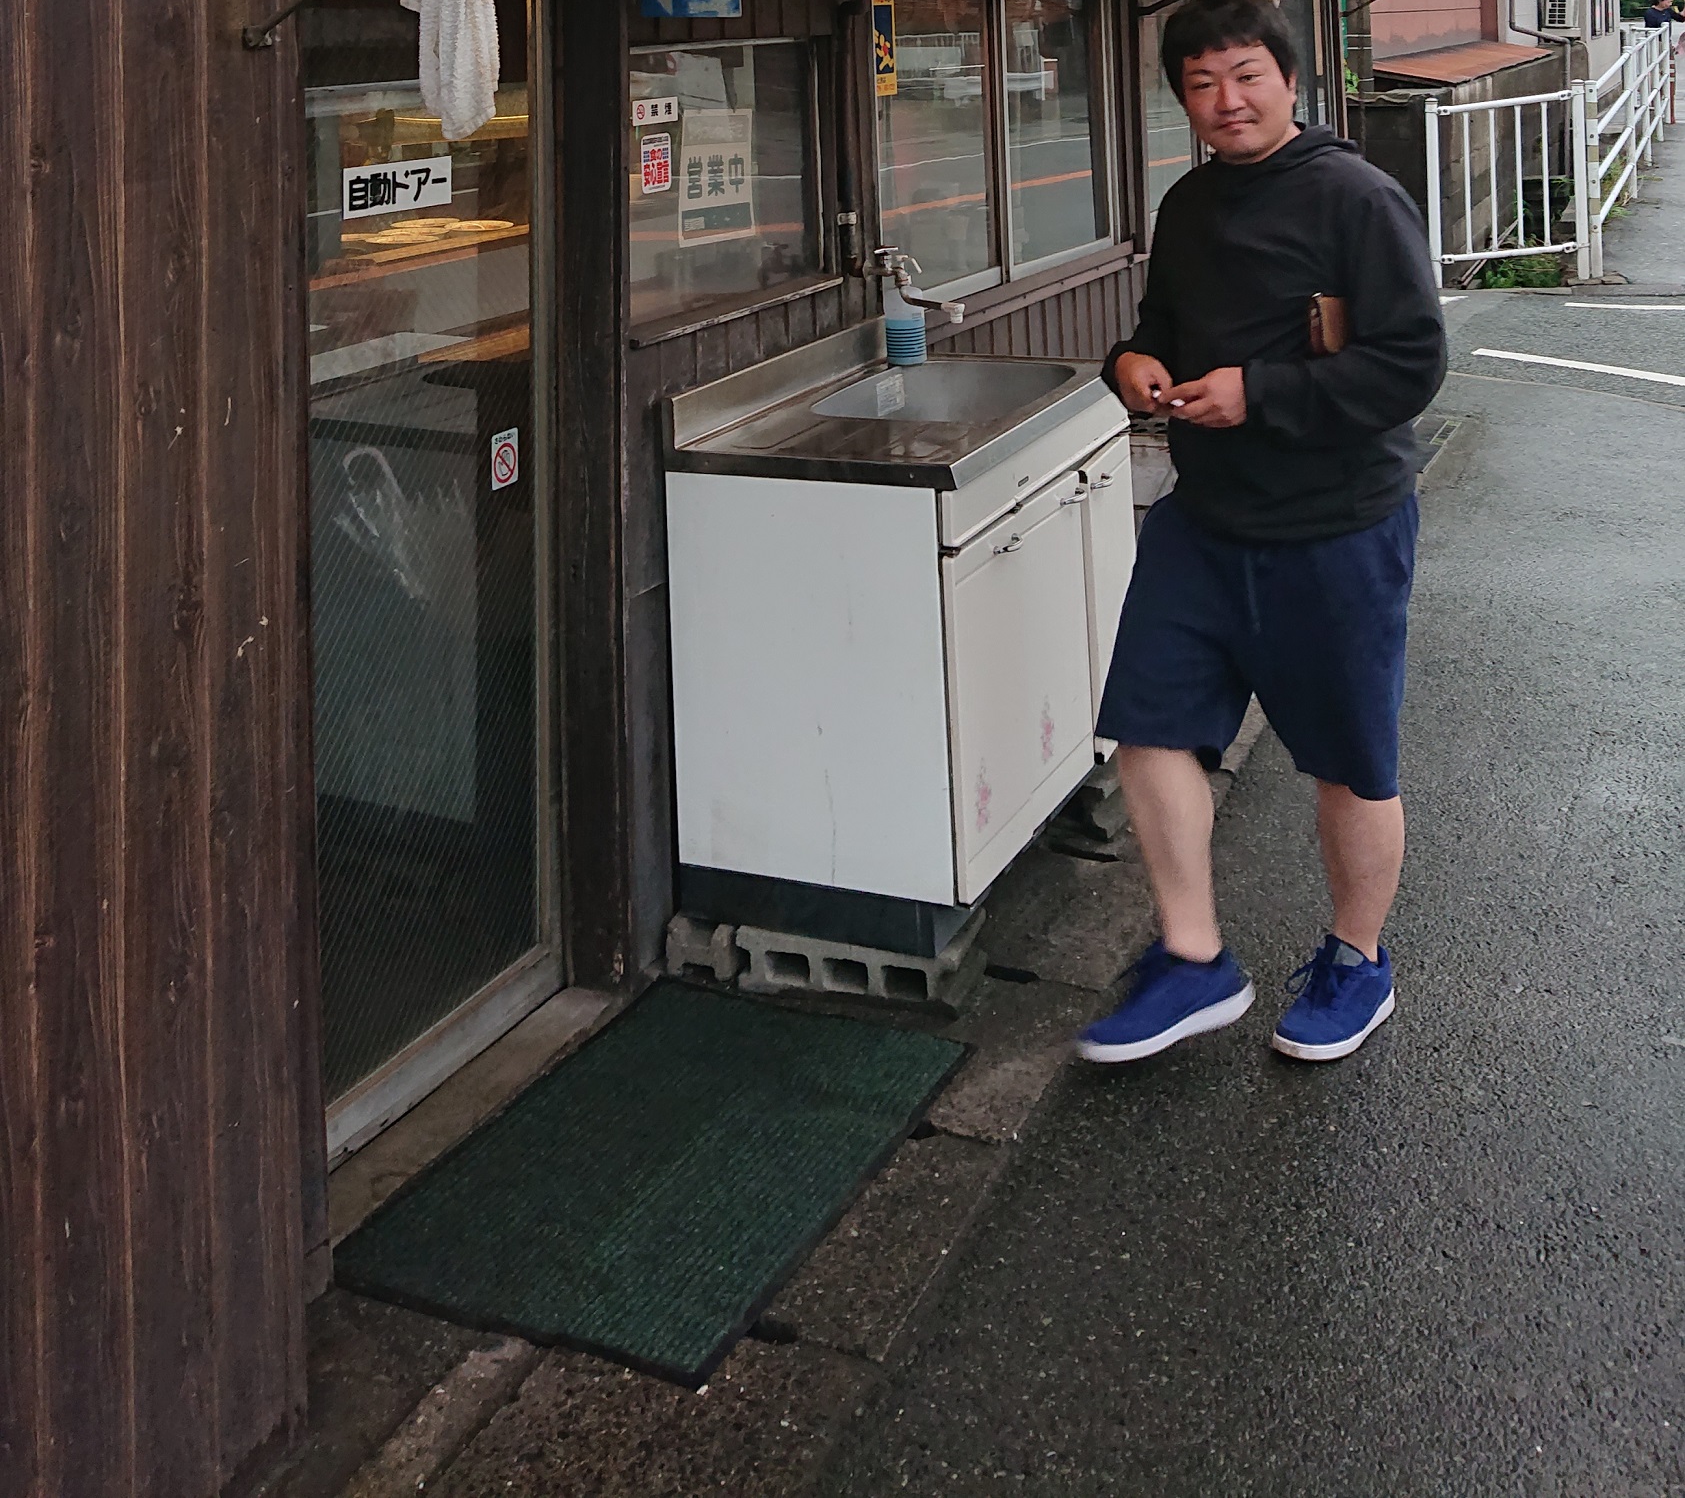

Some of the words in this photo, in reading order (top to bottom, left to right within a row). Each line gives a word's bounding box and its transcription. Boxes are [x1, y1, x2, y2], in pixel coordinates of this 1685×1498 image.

[650, 102, 673, 117] 禁煙
[348, 167, 448, 212] 自動ドアー
[687, 153, 745, 199] 営業中
